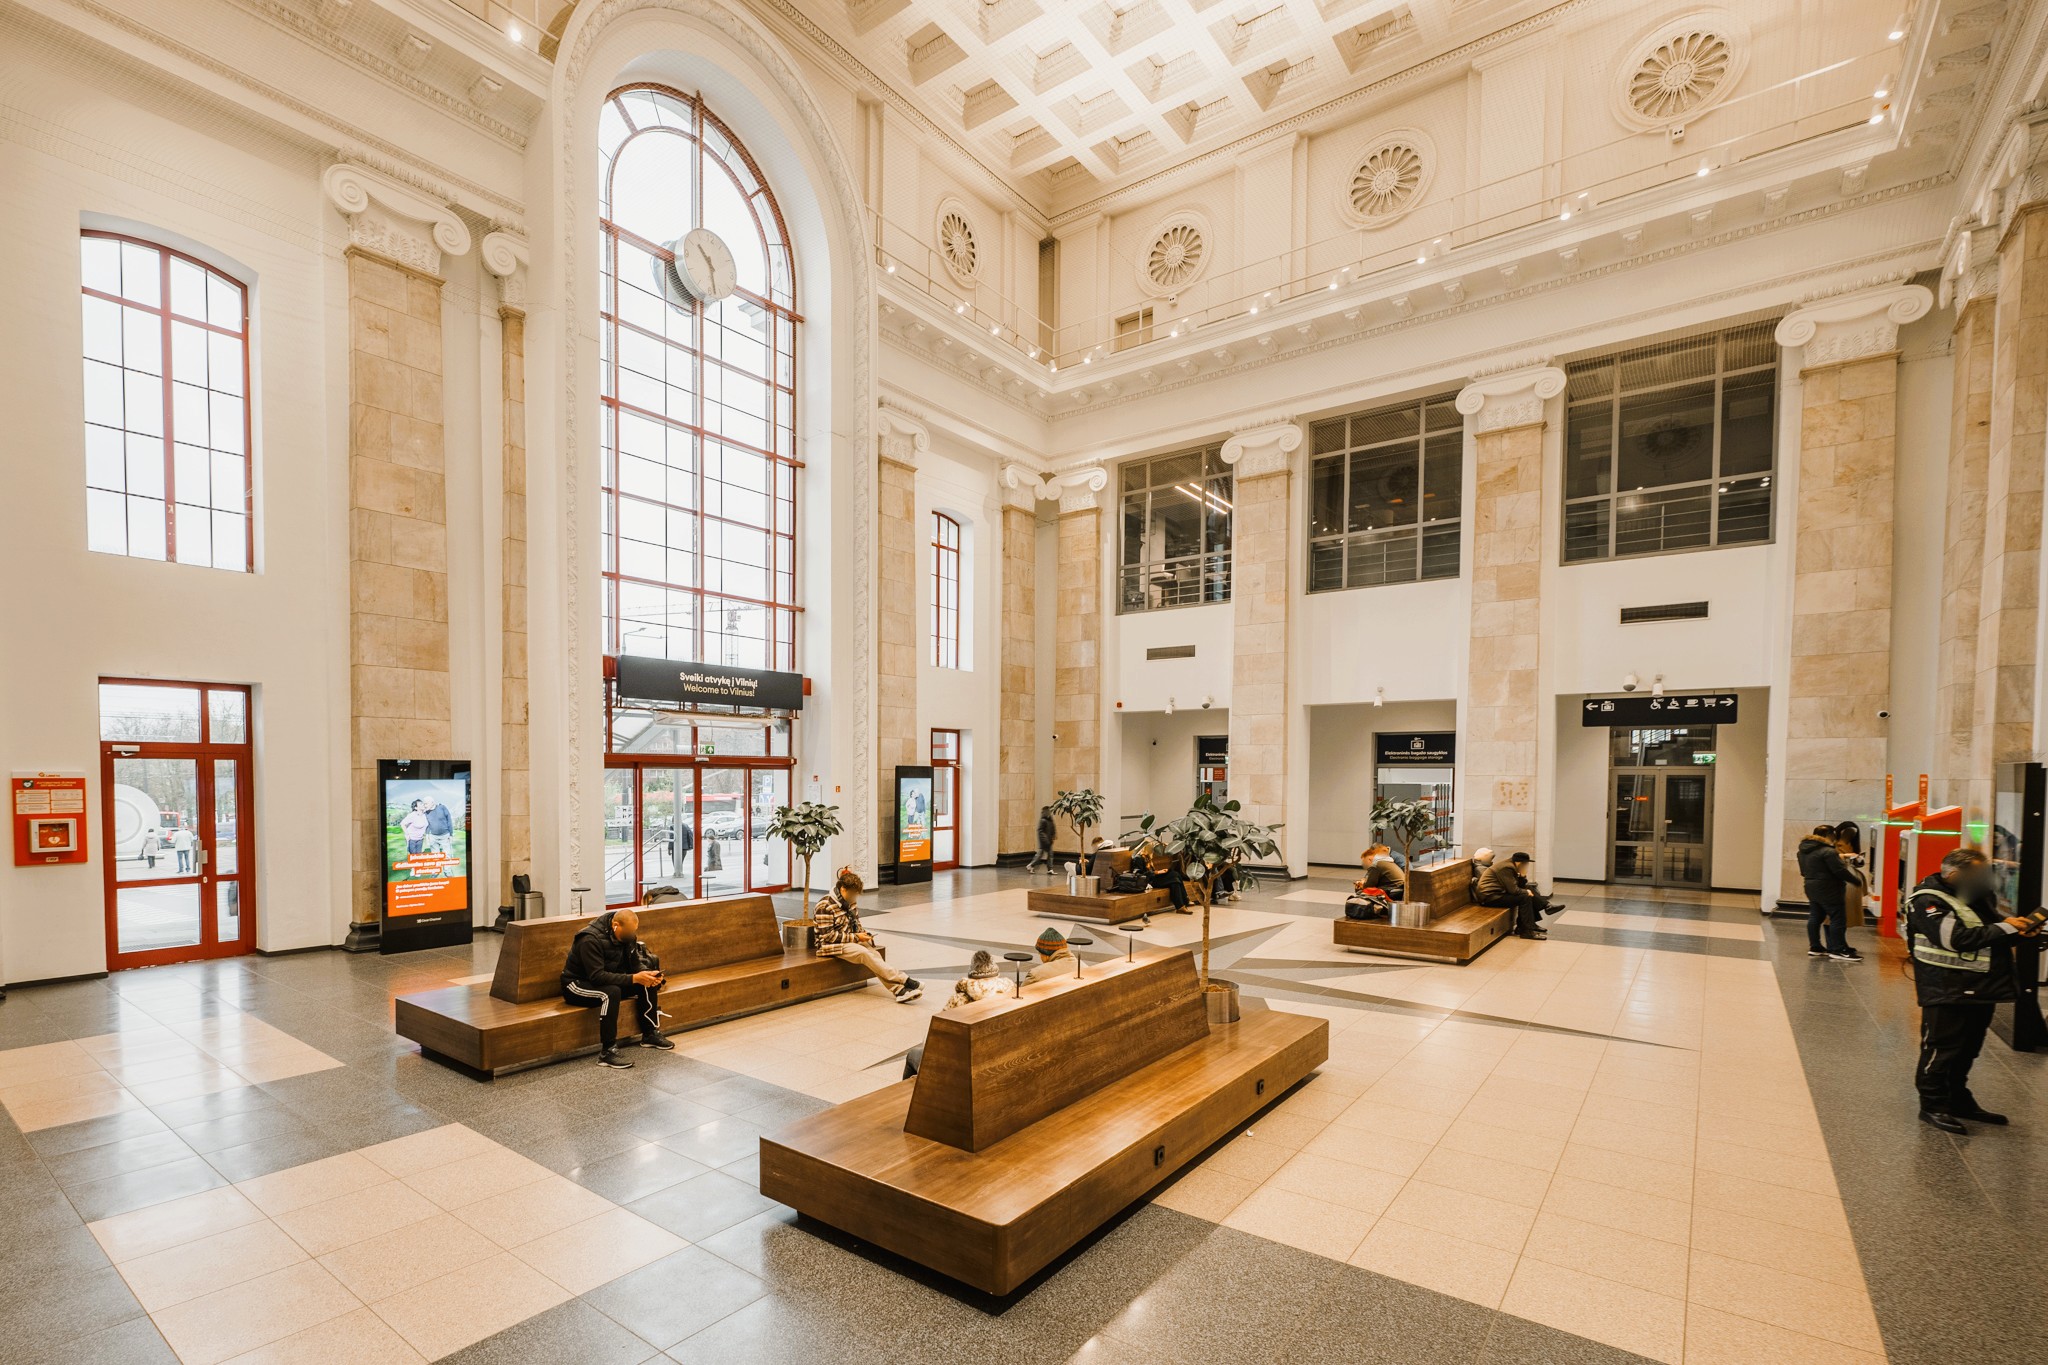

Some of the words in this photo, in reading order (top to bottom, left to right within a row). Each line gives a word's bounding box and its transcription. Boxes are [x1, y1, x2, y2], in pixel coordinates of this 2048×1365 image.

[679, 672, 704, 683] Sveiki
[704, 676, 731, 687] atvykę
[683, 682, 720, 694] Welcome
[720, 687, 729, 696] to
[729, 687, 755, 697] Vilnius!
